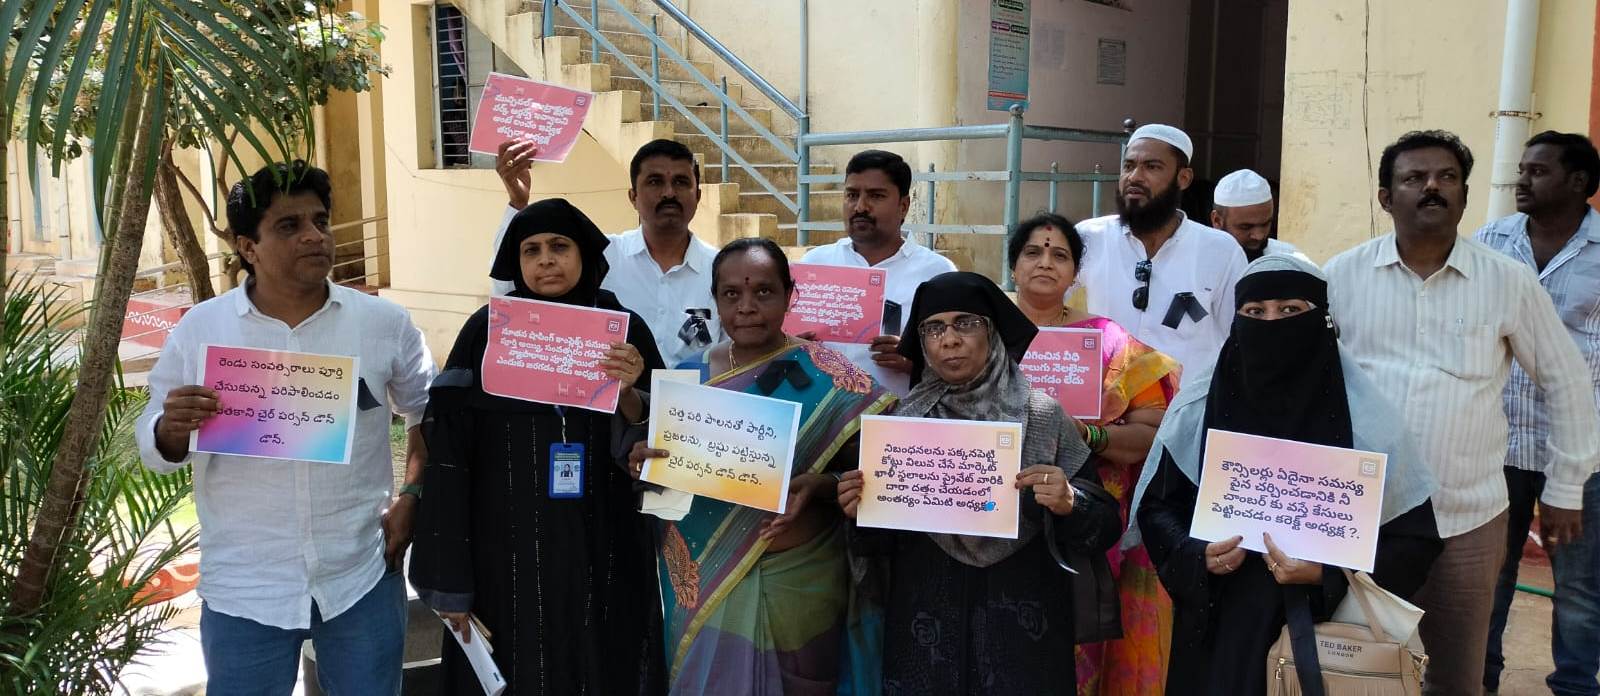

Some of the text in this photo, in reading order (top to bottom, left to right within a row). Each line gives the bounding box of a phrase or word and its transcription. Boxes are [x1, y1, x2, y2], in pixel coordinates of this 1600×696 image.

[219, 357, 344, 380] రెండు సంవత్సరాలు పూర్తి
[214, 380, 340, 401] చేసుకున్న పరిపాలించడం
[278, 410, 311, 426] పర్సన్
[669, 407, 685, 421] చెత్త
[704, 414, 744, 431] పాలనతో
[884, 444, 996, 463] నిబంధనలను పక్కనపెట్టి
[686, 460, 713, 478] పర్సన్
[905, 458, 935, 468] విలువ
[938, 458, 956, 469] చేసే
[958, 461, 998, 475] మార్కెట్
[875, 467, 896, 478] ఖాళీ
[942, 472, 975, 486] ప్రైవేట్
[976, 475, 1004, 485] వారికి
[1221, 460, 1364, 497] కౌన్సిలర్లు ఏదైనా సమస్య
[938, 485, 991, 497] చేయడంలో
[1230, 476, 1351, 506] పైన చర్చించడానికి నీ
[1223, 492, 1353, 522] చాంబర్ కు వస్తే కేసులు
[1211, 502, 1272, 522] పెట్టించడం
[1275, 515, 1302, 531] కరెక్ట్
[1305, 520, 1346, 539] అధ్యక్ష
[1320, 640, 1363, 653] TED BAKER
[1327, 650, 1354, 658] LONDON
